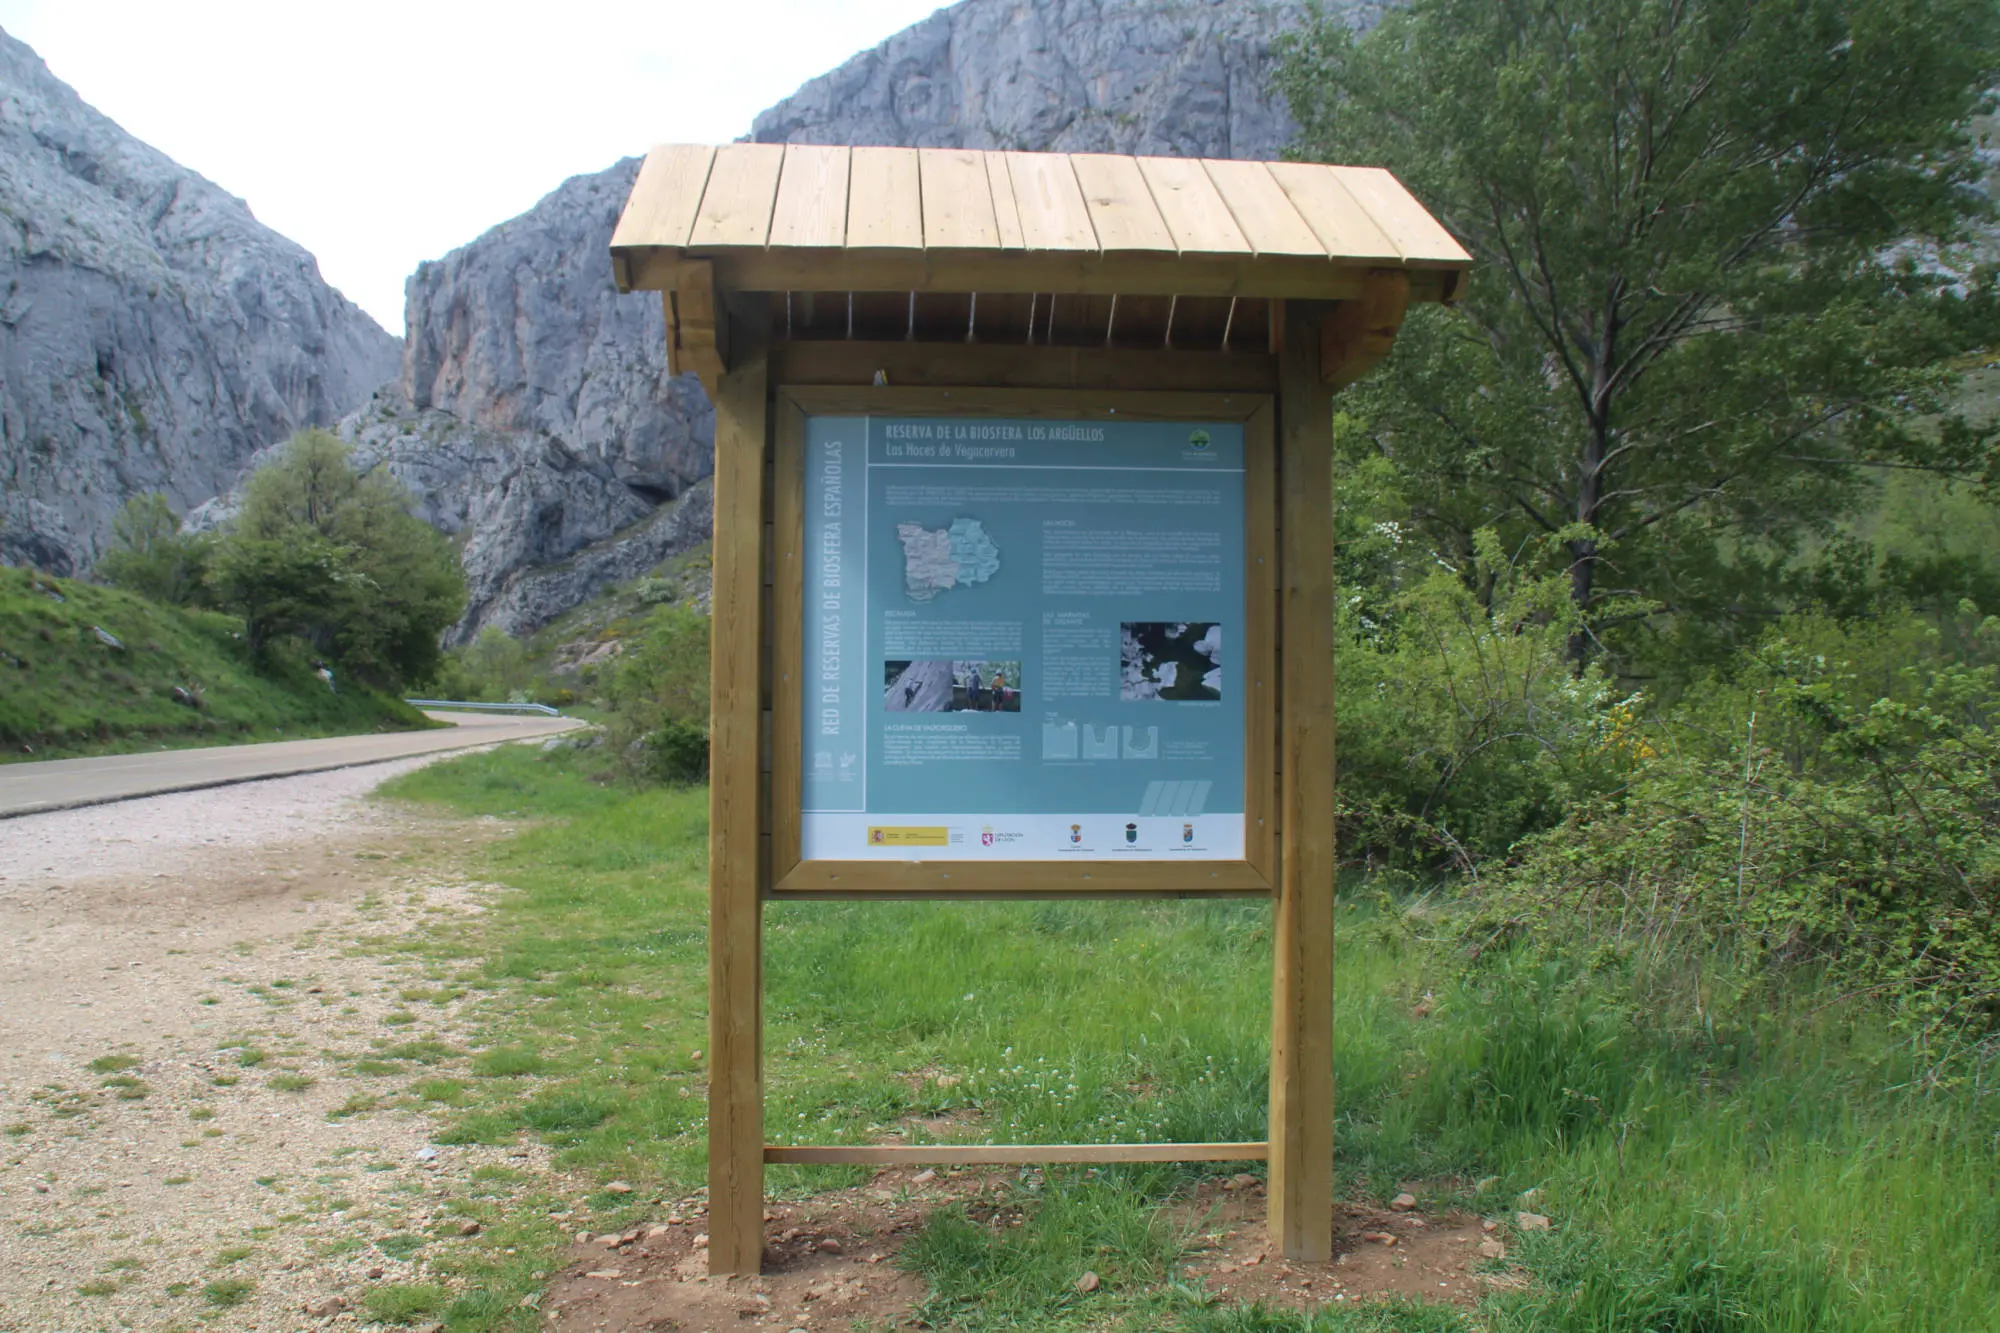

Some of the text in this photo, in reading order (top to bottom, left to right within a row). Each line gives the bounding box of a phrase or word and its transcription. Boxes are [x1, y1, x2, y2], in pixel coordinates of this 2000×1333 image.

[886, 425, 1104, 441] RESERVA DE LA BIOSFERA LOS ARGÜELLOS
[886, 443, 903, 456] Las
[906, 443, 936, 456] Hoces
[939, 443, 951, 457] de
[821, 440, 843, 735] RED DE RESERVAS DE BIOSFERA ESPAÑOLAS
